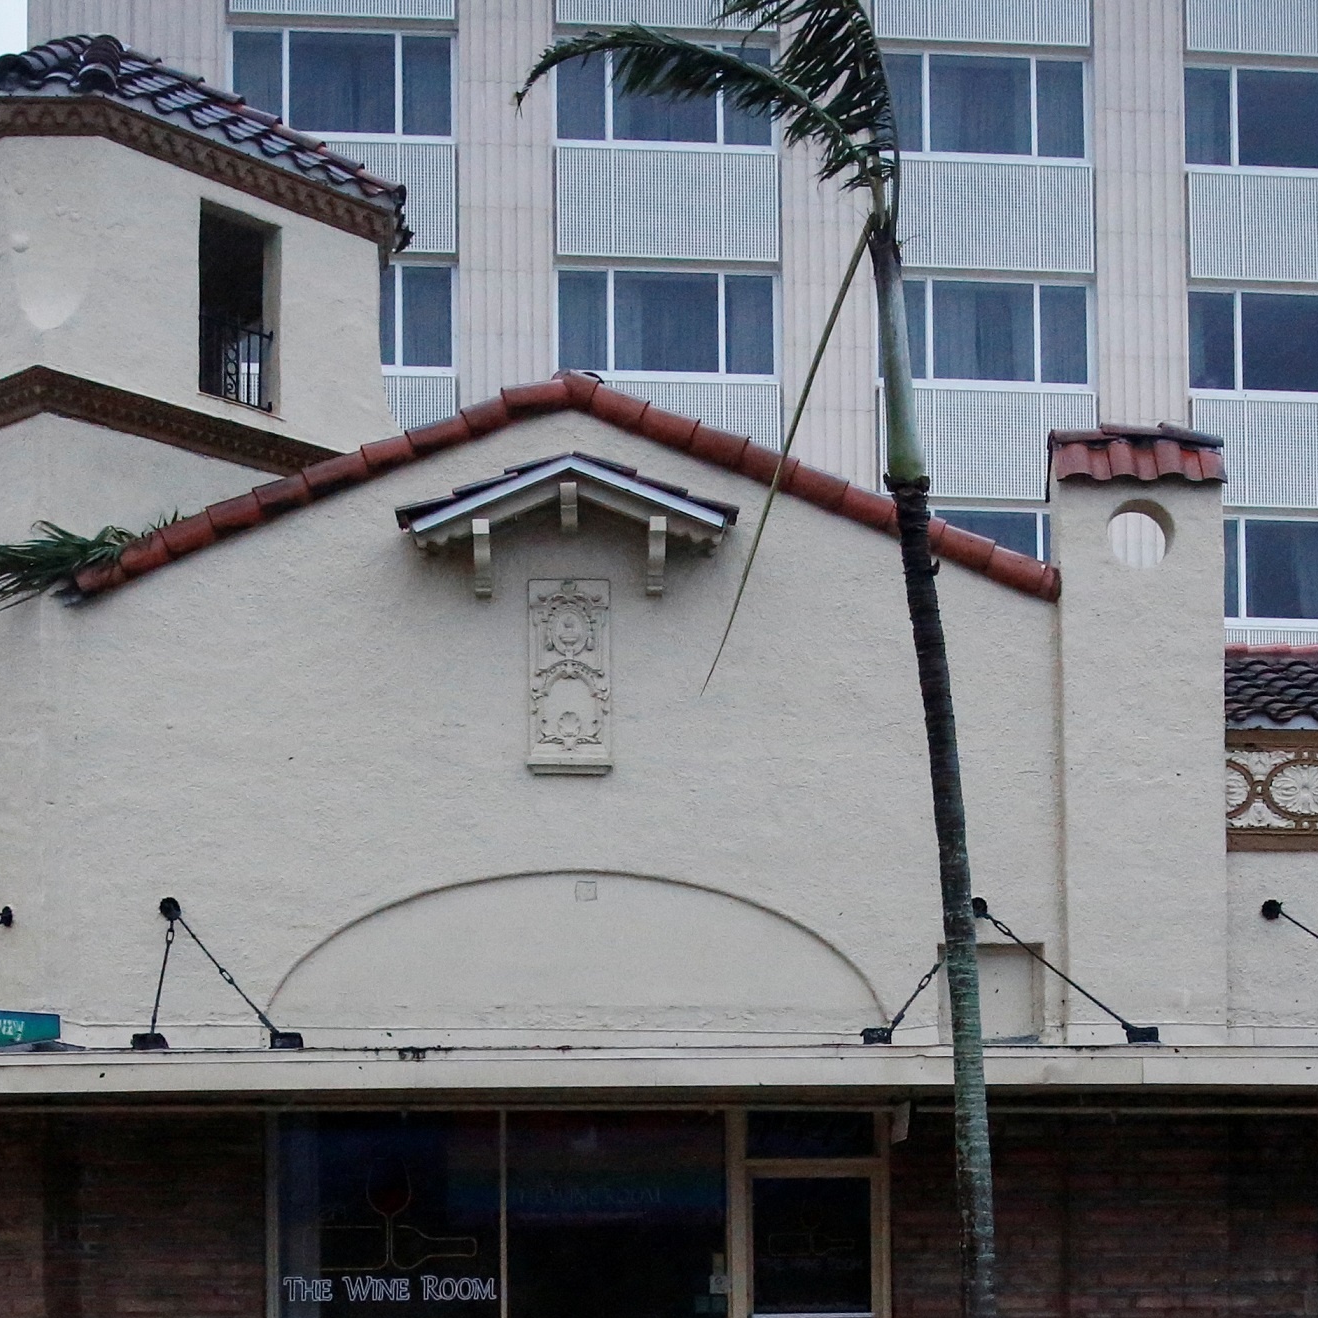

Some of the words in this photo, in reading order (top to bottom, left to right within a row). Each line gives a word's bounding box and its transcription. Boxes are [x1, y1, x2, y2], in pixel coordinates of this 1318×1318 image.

[283, 1277, 333, 1301] THE
[341, 1275, 411, 1301] WINE
[420, 1275, 497, 1301] ROOM
